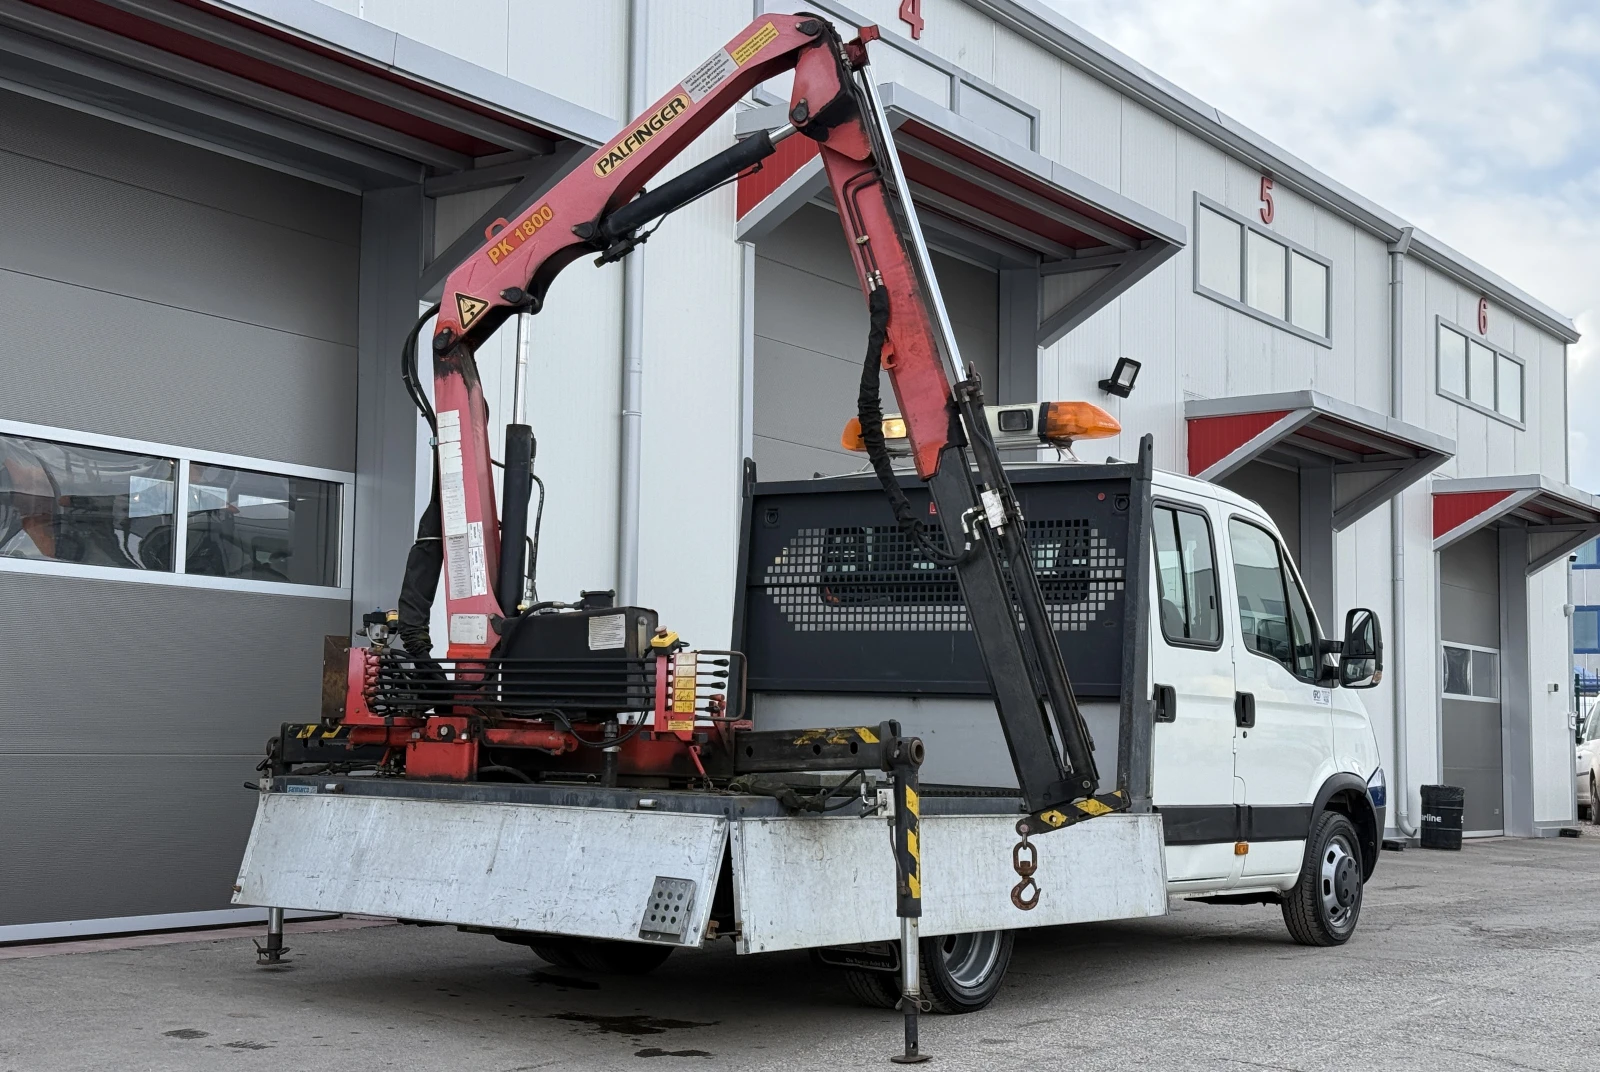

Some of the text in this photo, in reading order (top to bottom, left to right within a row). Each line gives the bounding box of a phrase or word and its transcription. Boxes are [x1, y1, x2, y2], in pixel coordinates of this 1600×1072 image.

[899, 0, 924, 40] 4
[597, 97, 686, 174] PALFINGER
[1260, 176, 1274, 224] 5
[487, 205, 553, 264] PK 1800
[1479, 297, 1488, 335] 6
